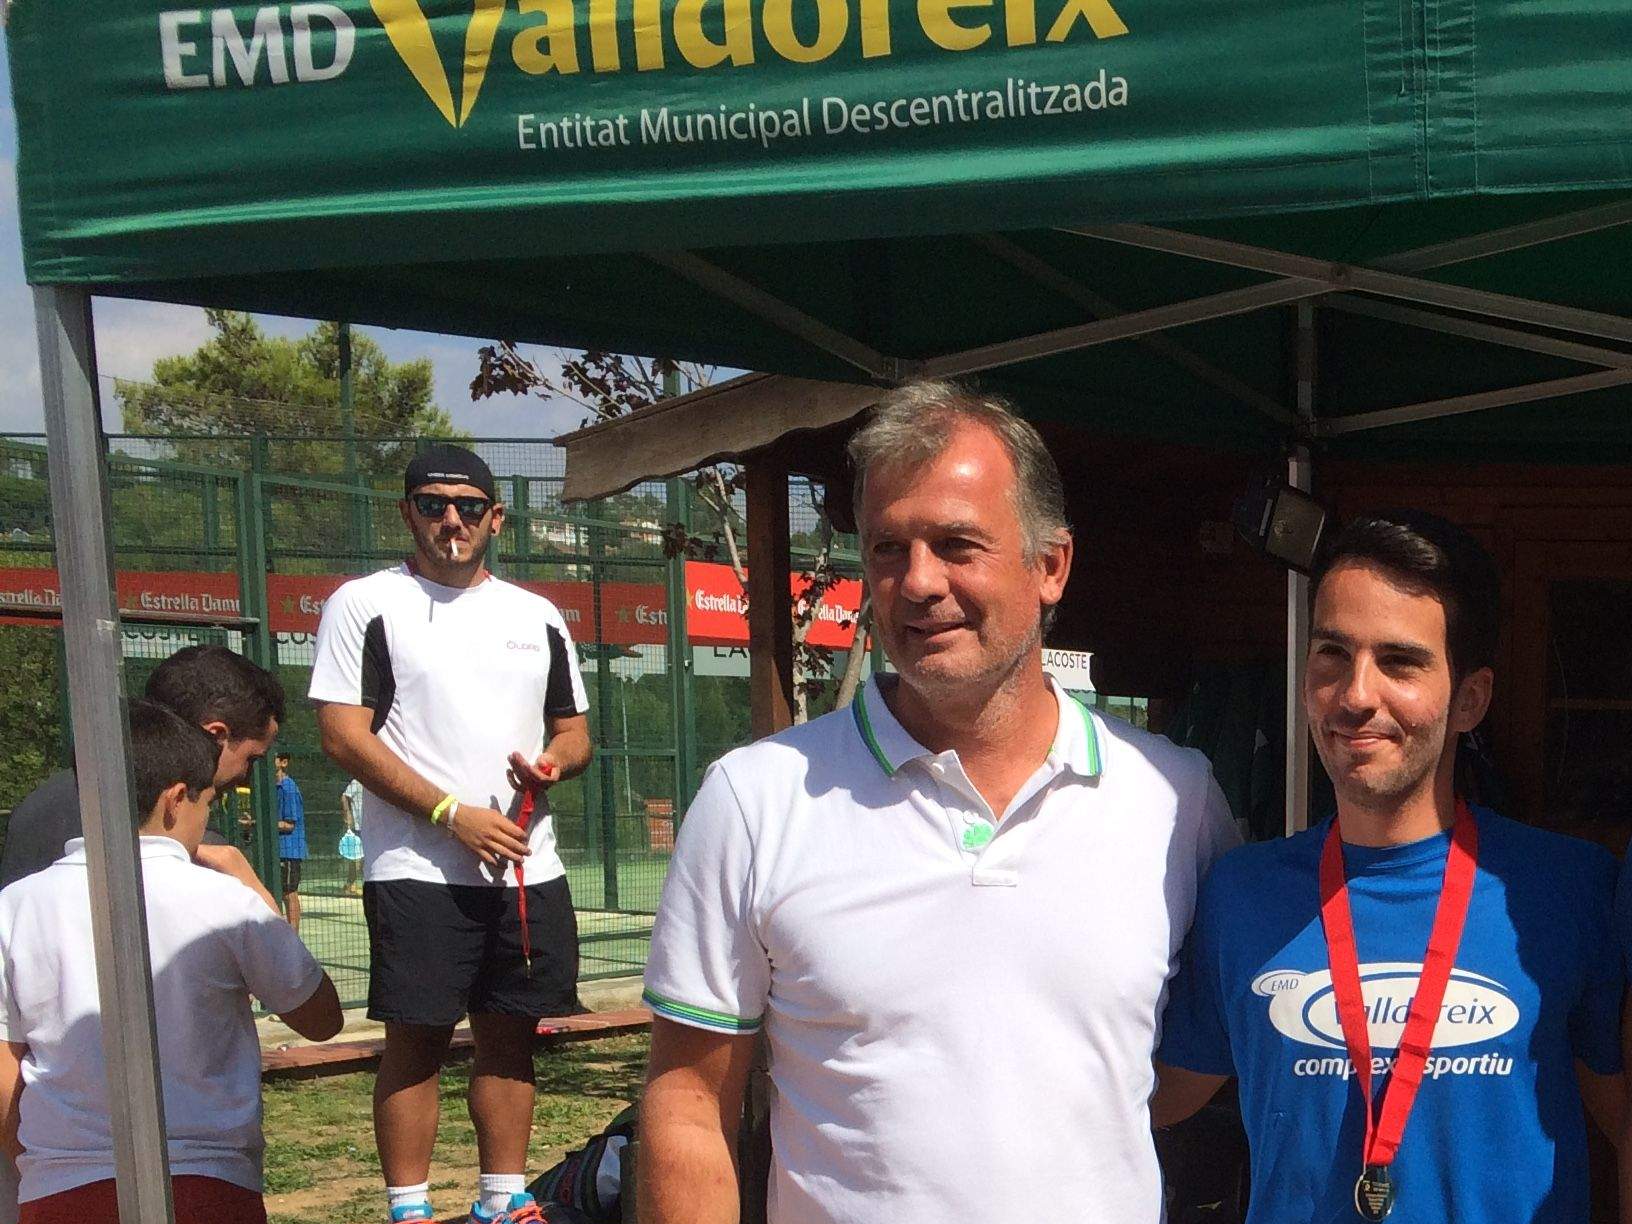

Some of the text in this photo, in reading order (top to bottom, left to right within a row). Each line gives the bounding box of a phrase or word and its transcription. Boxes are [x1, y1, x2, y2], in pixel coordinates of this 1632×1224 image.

[159, 4, 357, 89] EMD
[518, 69, 1129, 150] Entitat Municipal Descentralitzada
[140, 592, 200, 611] Estrella
[695, 588, 737, 612] Estrella
[1271, 978, 1299, 991] EMD
